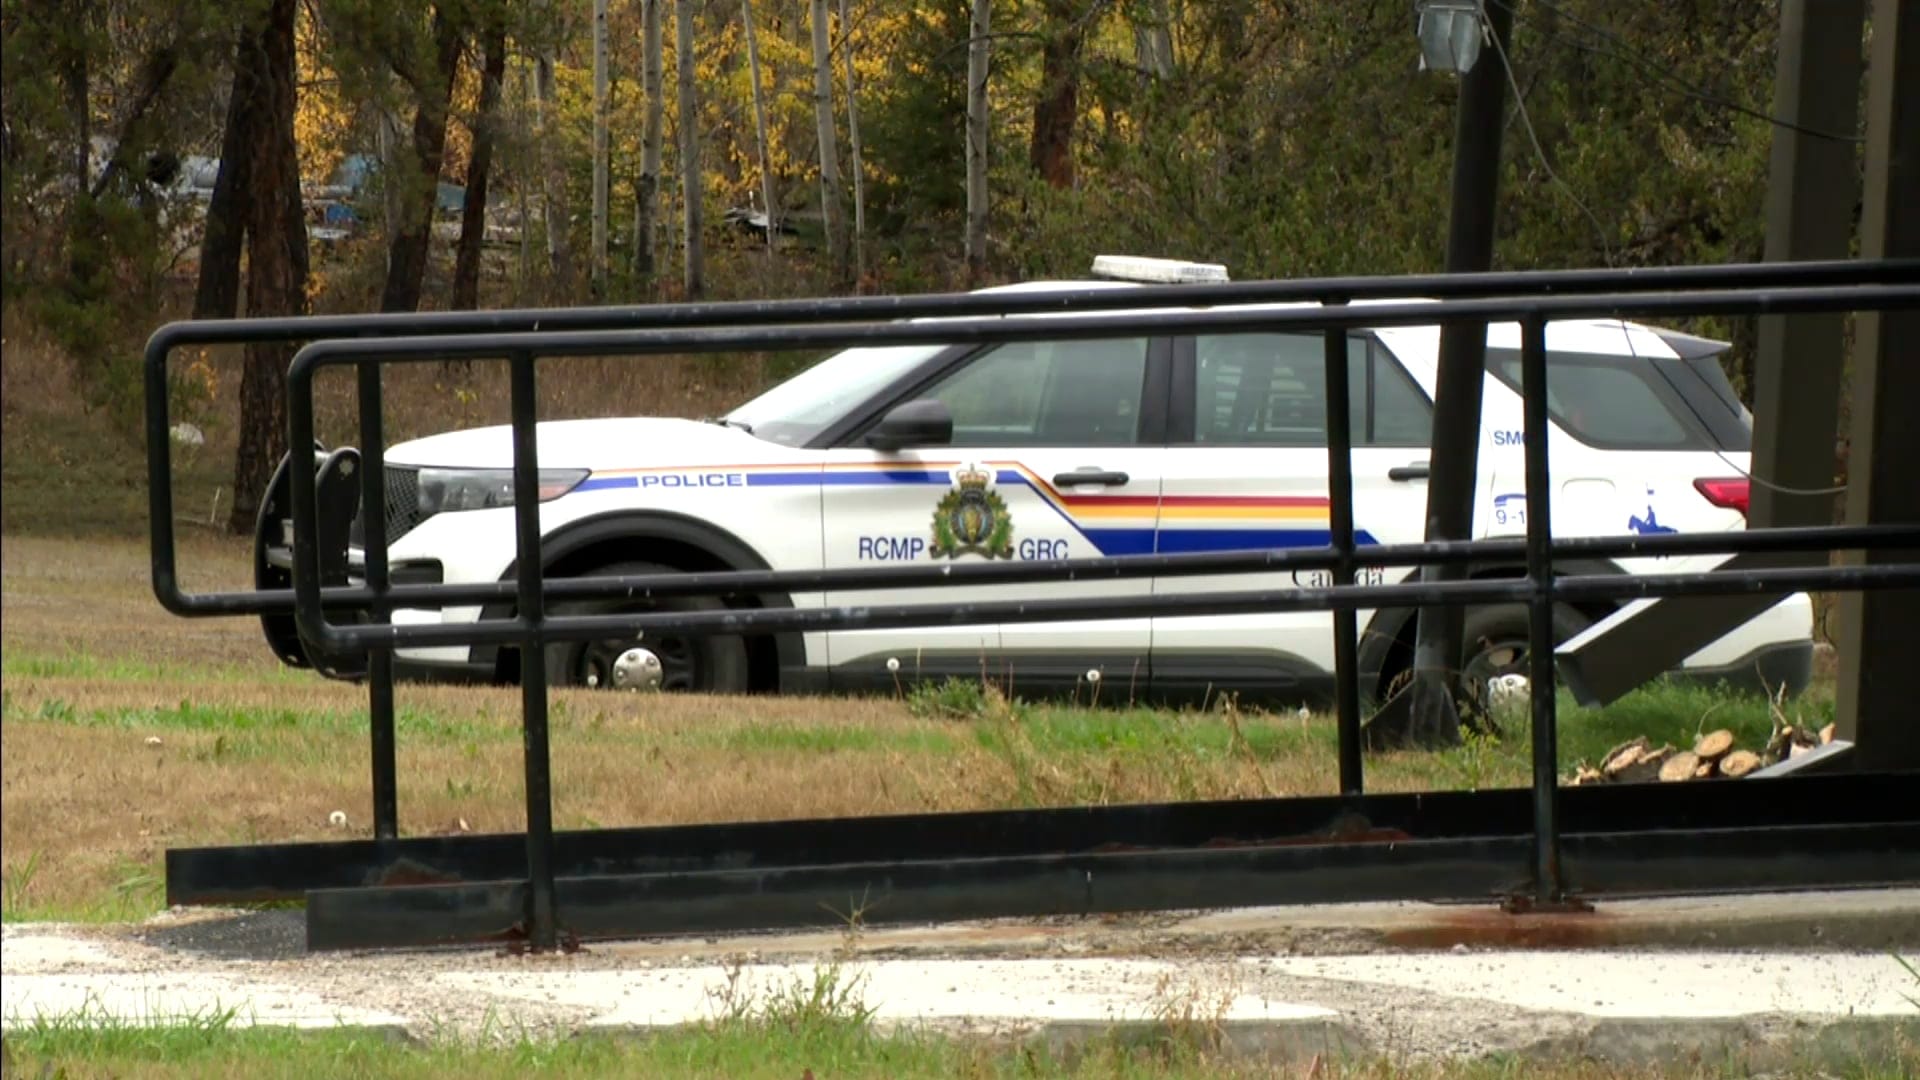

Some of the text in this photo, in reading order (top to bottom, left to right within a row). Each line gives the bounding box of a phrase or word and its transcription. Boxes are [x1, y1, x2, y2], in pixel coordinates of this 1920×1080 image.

[641, 473, 743, 488] POLICE
[858, 536, 924, 560] RCMP
[1019, 538, 1069, 560] GRC
